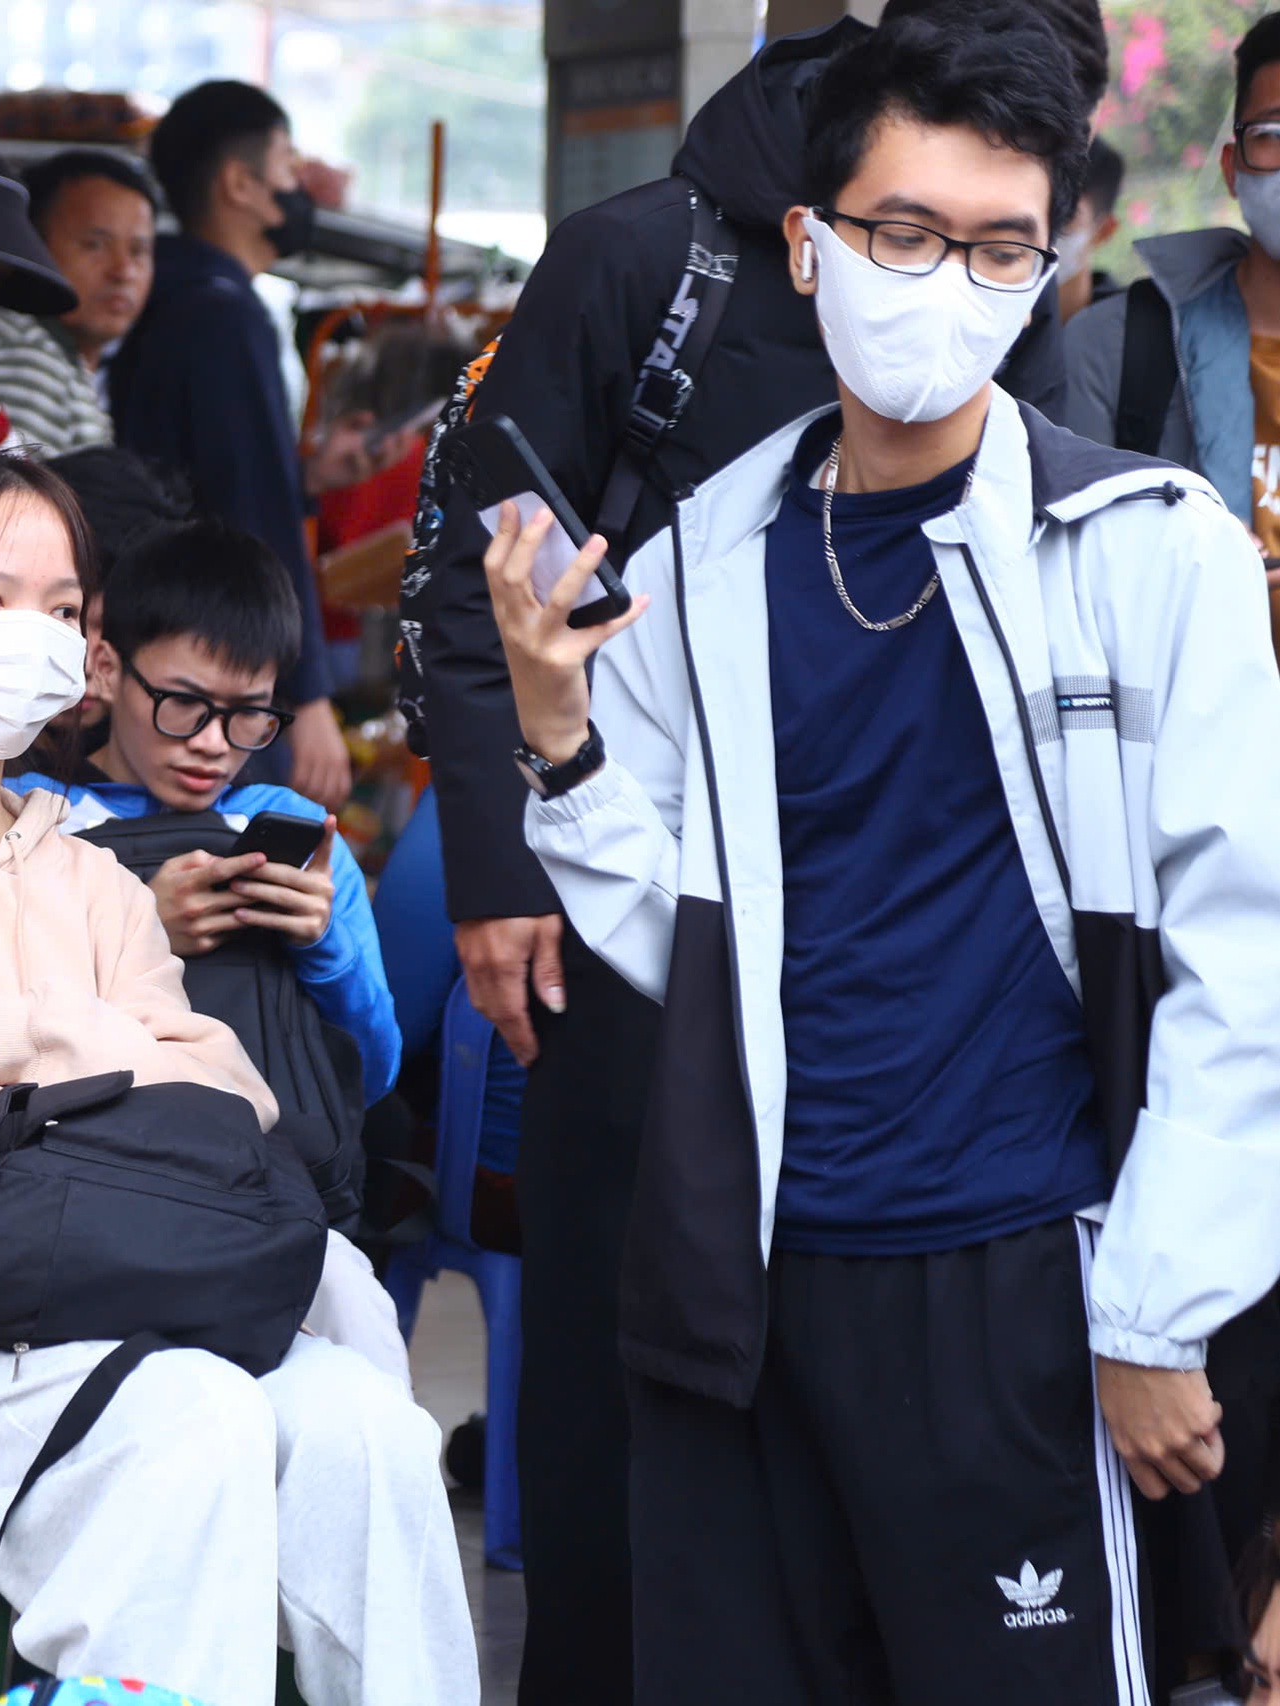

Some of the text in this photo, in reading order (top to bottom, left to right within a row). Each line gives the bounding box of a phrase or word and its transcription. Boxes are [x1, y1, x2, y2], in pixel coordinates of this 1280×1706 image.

[634, 272, 699, 398] STA
[1071, 697, 1111, 707] SPORTY
[1003, 1607, 1068, 1628] adidas
